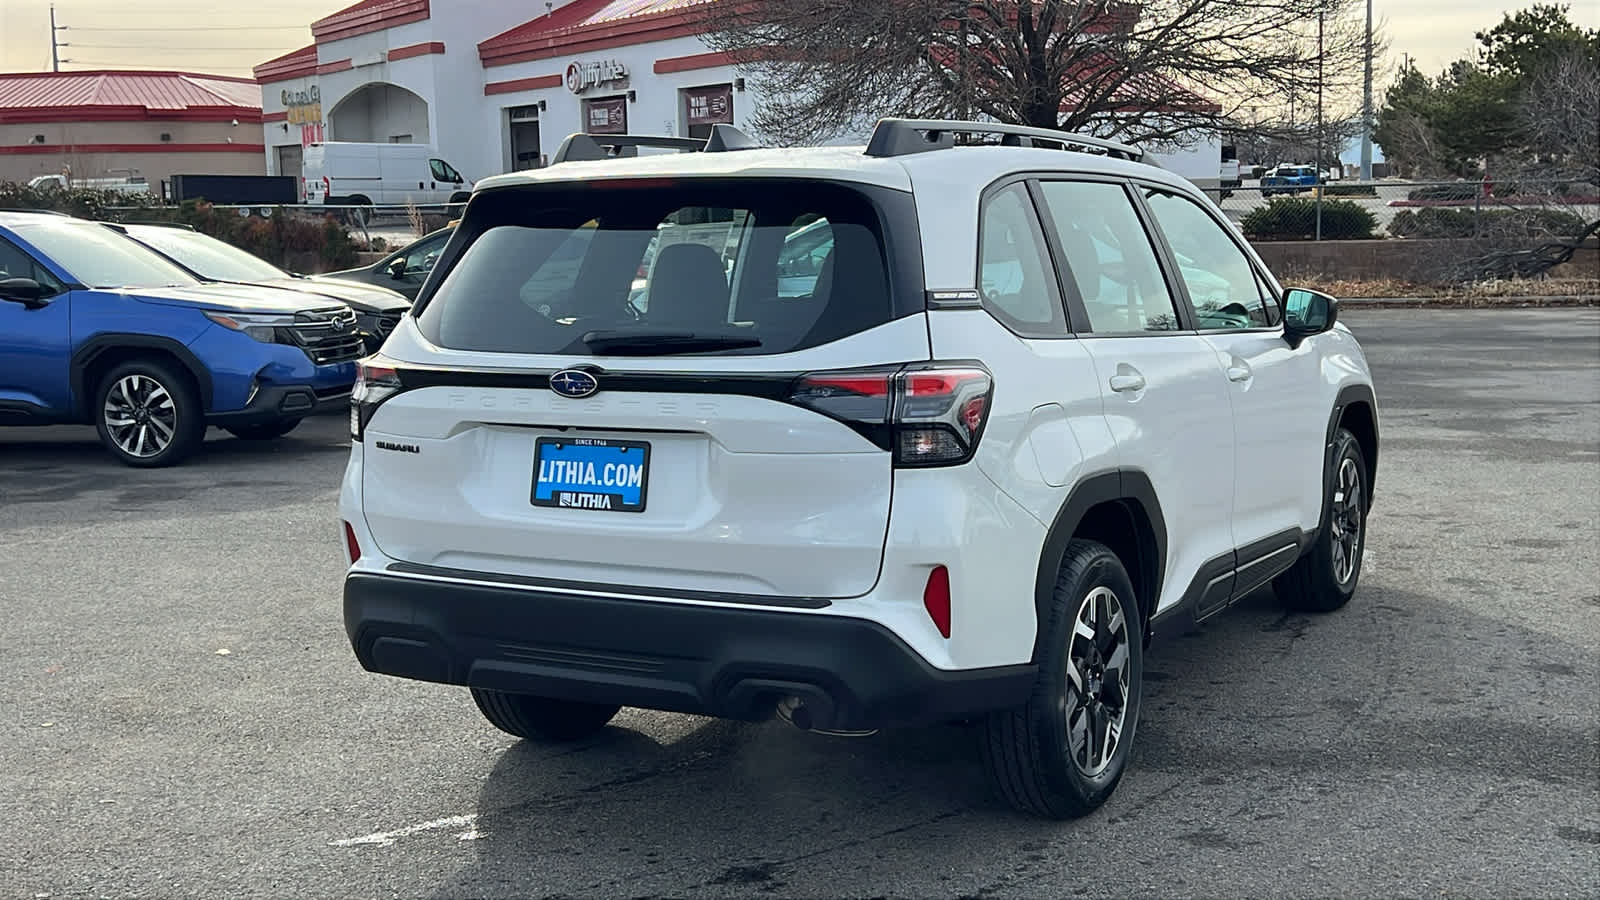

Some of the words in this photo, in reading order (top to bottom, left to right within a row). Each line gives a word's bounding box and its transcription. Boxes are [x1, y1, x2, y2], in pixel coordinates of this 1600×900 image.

[448, 393, 720, 417] FORESTER
[375, 440, 420, 454] SUBARU
[575, 438, 592, 446] SINCE
[537, 459, 644, 488] LITHIA.COM
[571, 492, 612, 510] LITHIA
